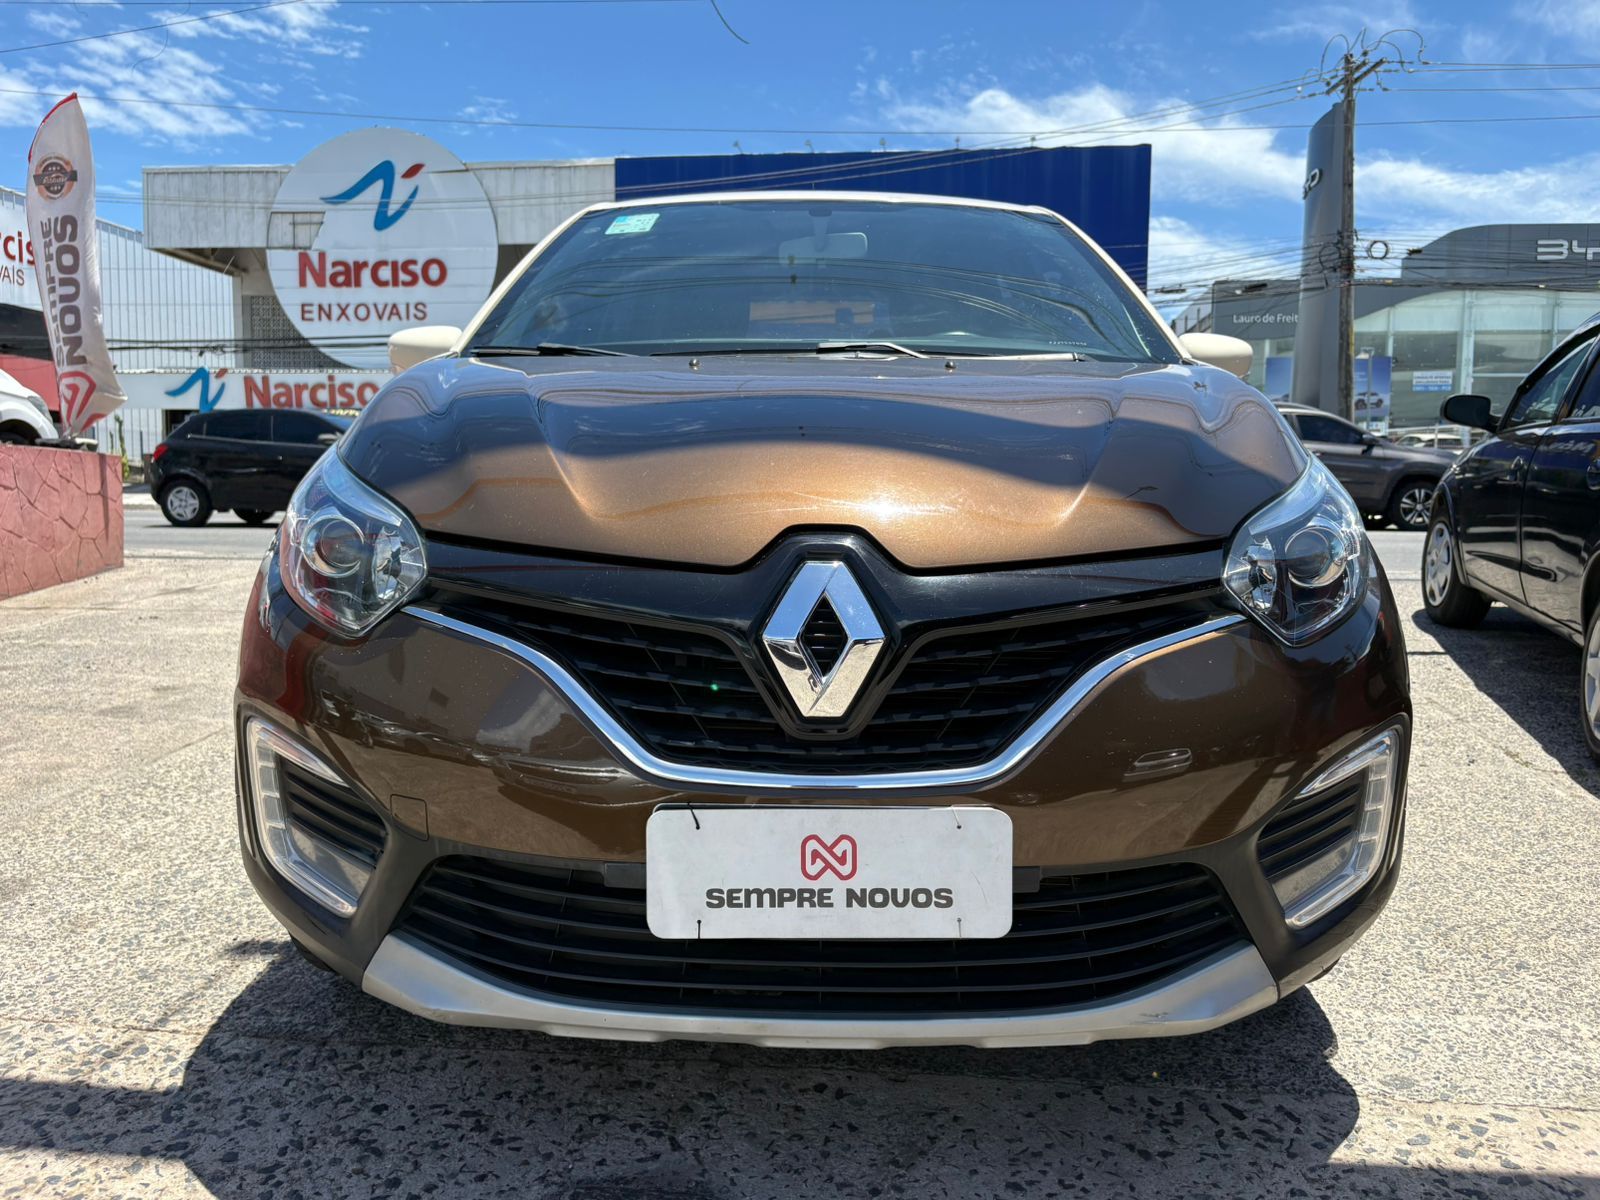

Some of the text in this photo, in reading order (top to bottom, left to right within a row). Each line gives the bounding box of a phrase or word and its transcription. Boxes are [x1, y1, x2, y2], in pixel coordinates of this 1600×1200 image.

[298, 250, 448, 288] Narciso
[300, 301, 428, 323] ENXOVAIS
[1232, 313, 1262, 324] Lauro
[1262, 312, 1275, 324] de
[243, 374, 381, 409] Narciso
[705, 887, 834, 909] SEMPRE
